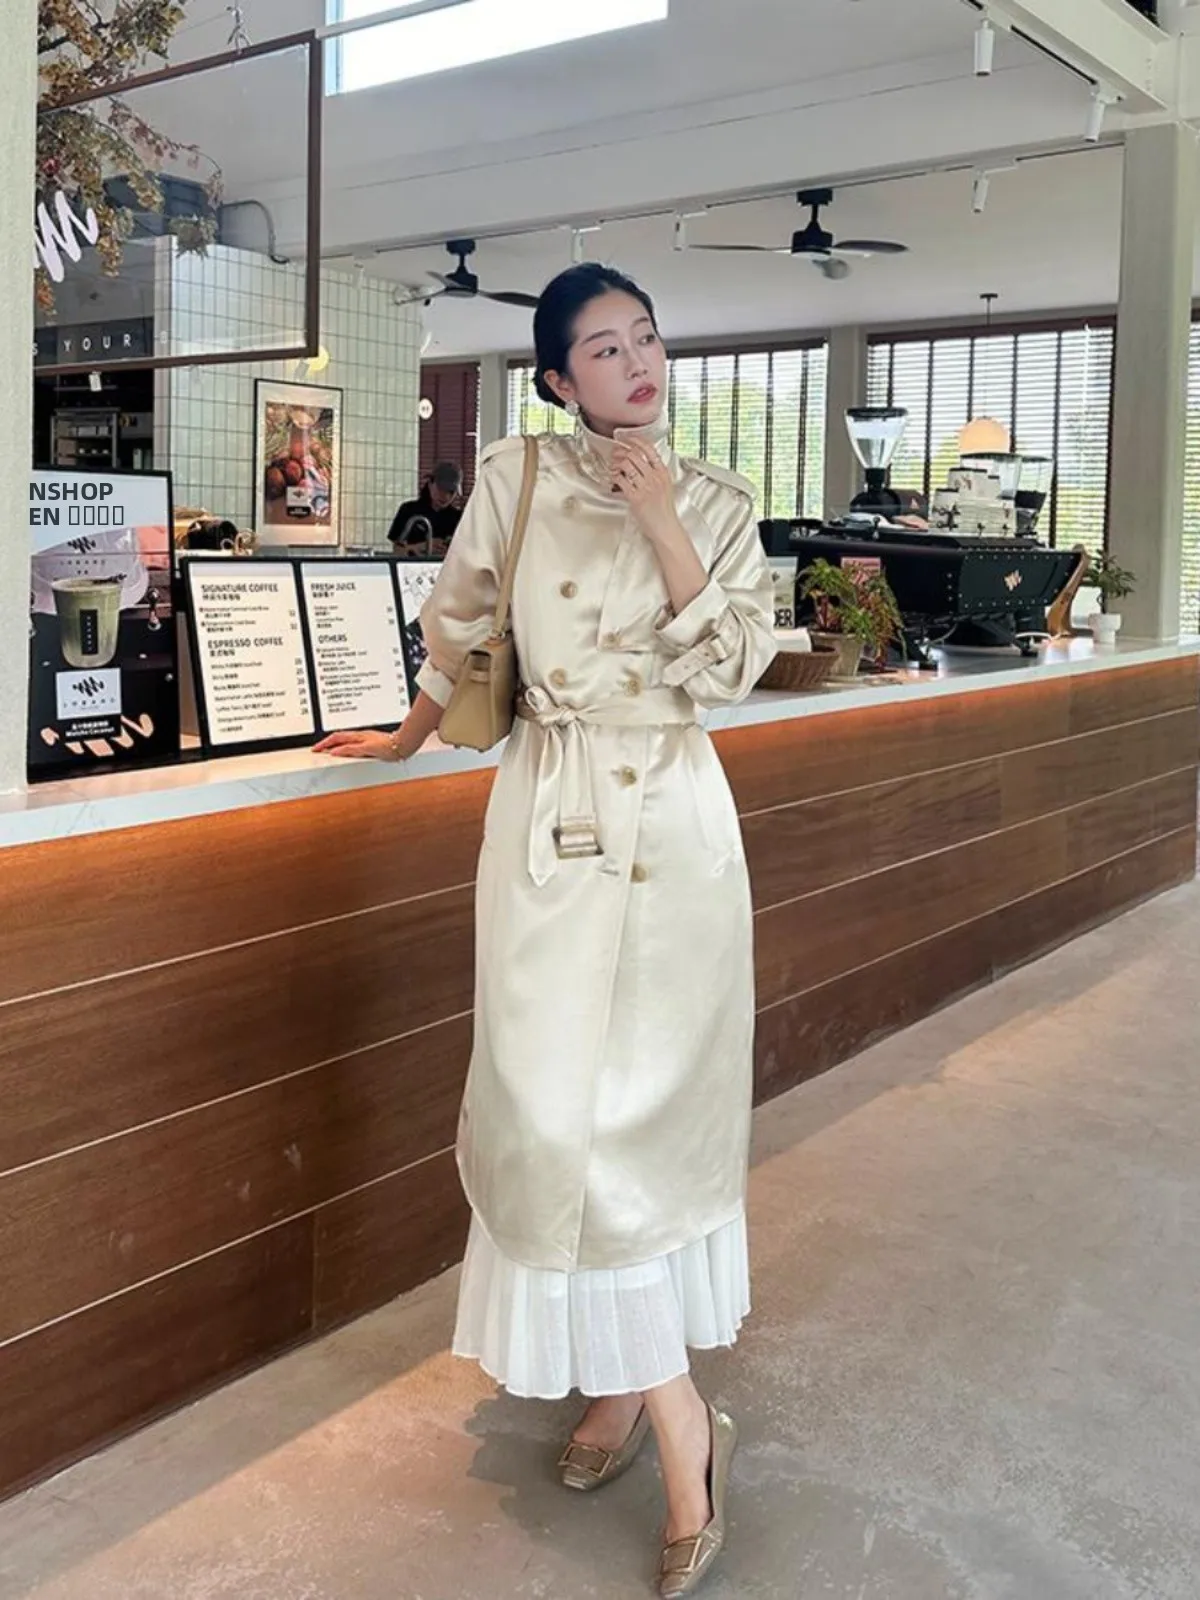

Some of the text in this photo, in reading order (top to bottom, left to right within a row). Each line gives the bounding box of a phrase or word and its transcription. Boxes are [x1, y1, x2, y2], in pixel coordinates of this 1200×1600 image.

[64, 333, 131, 352] YOUR
[30, 483, 113, 500] NSHOP
[30, 508, 59, 525] EN
[201, 582, 279, 593] SIGNATURE COFFEE
[311, 582, 356, 591] FRESH JUICE
[208, 636, 284, 649] ESPRESSO COFFEE
[318, 634, 348, 644] OTHERS
